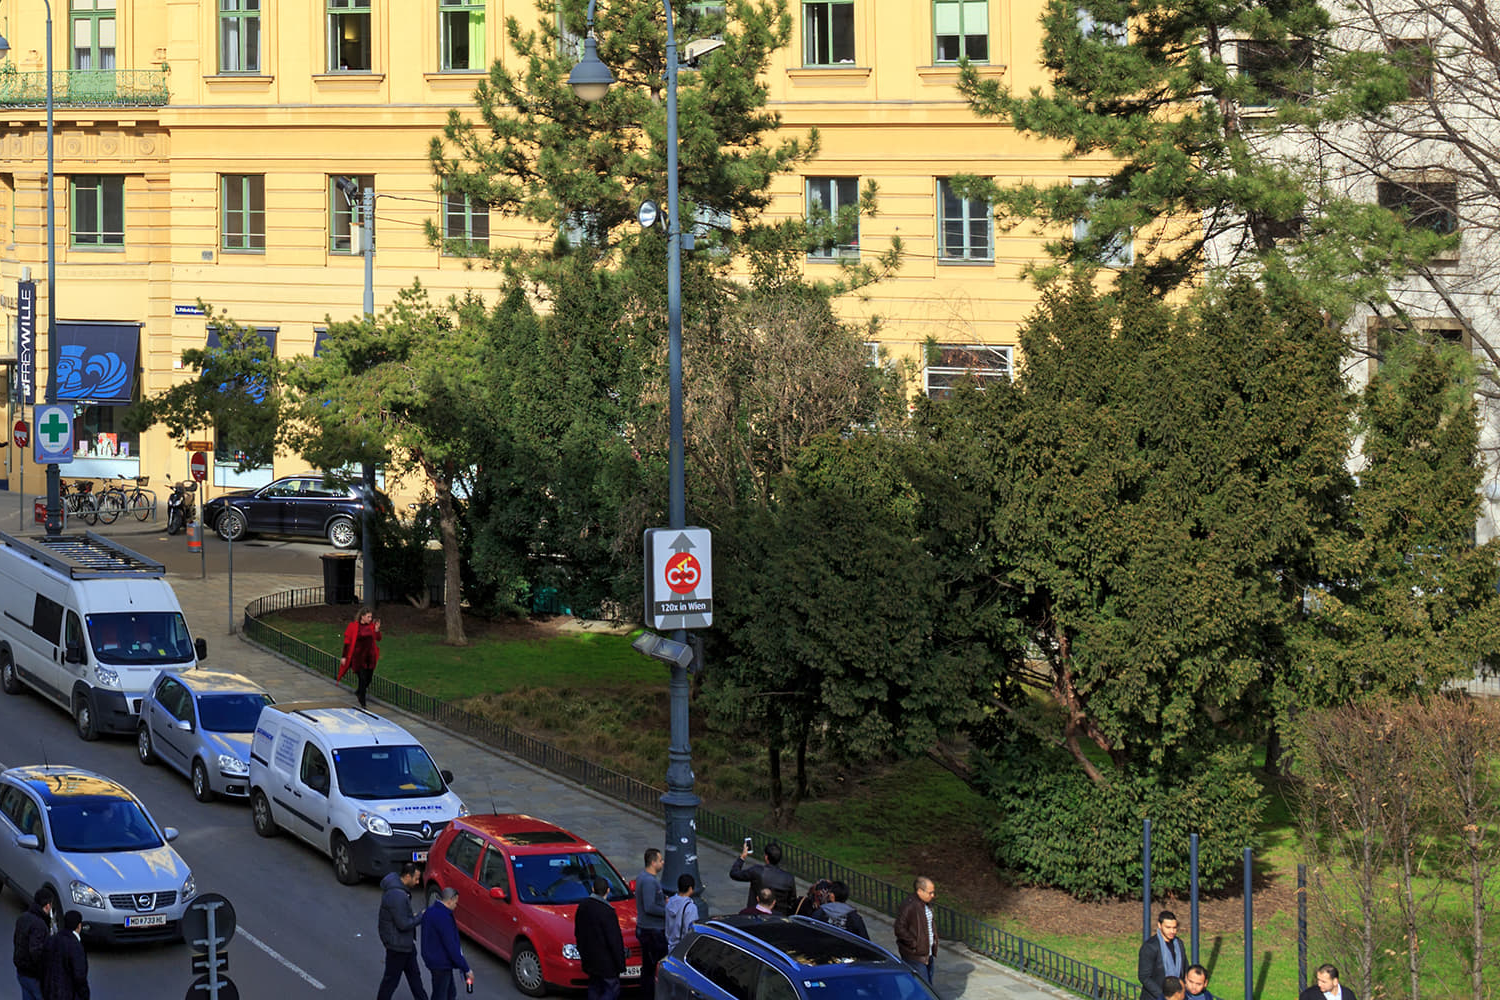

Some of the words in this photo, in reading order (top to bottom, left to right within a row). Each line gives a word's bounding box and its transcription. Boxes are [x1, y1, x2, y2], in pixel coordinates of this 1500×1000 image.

[21, 289, 31, 384] FREYWILLE
[661, 603, 678, 612] 120x
[680, 603, 687, 611] in
[688, 602, 706, 610] Wien
